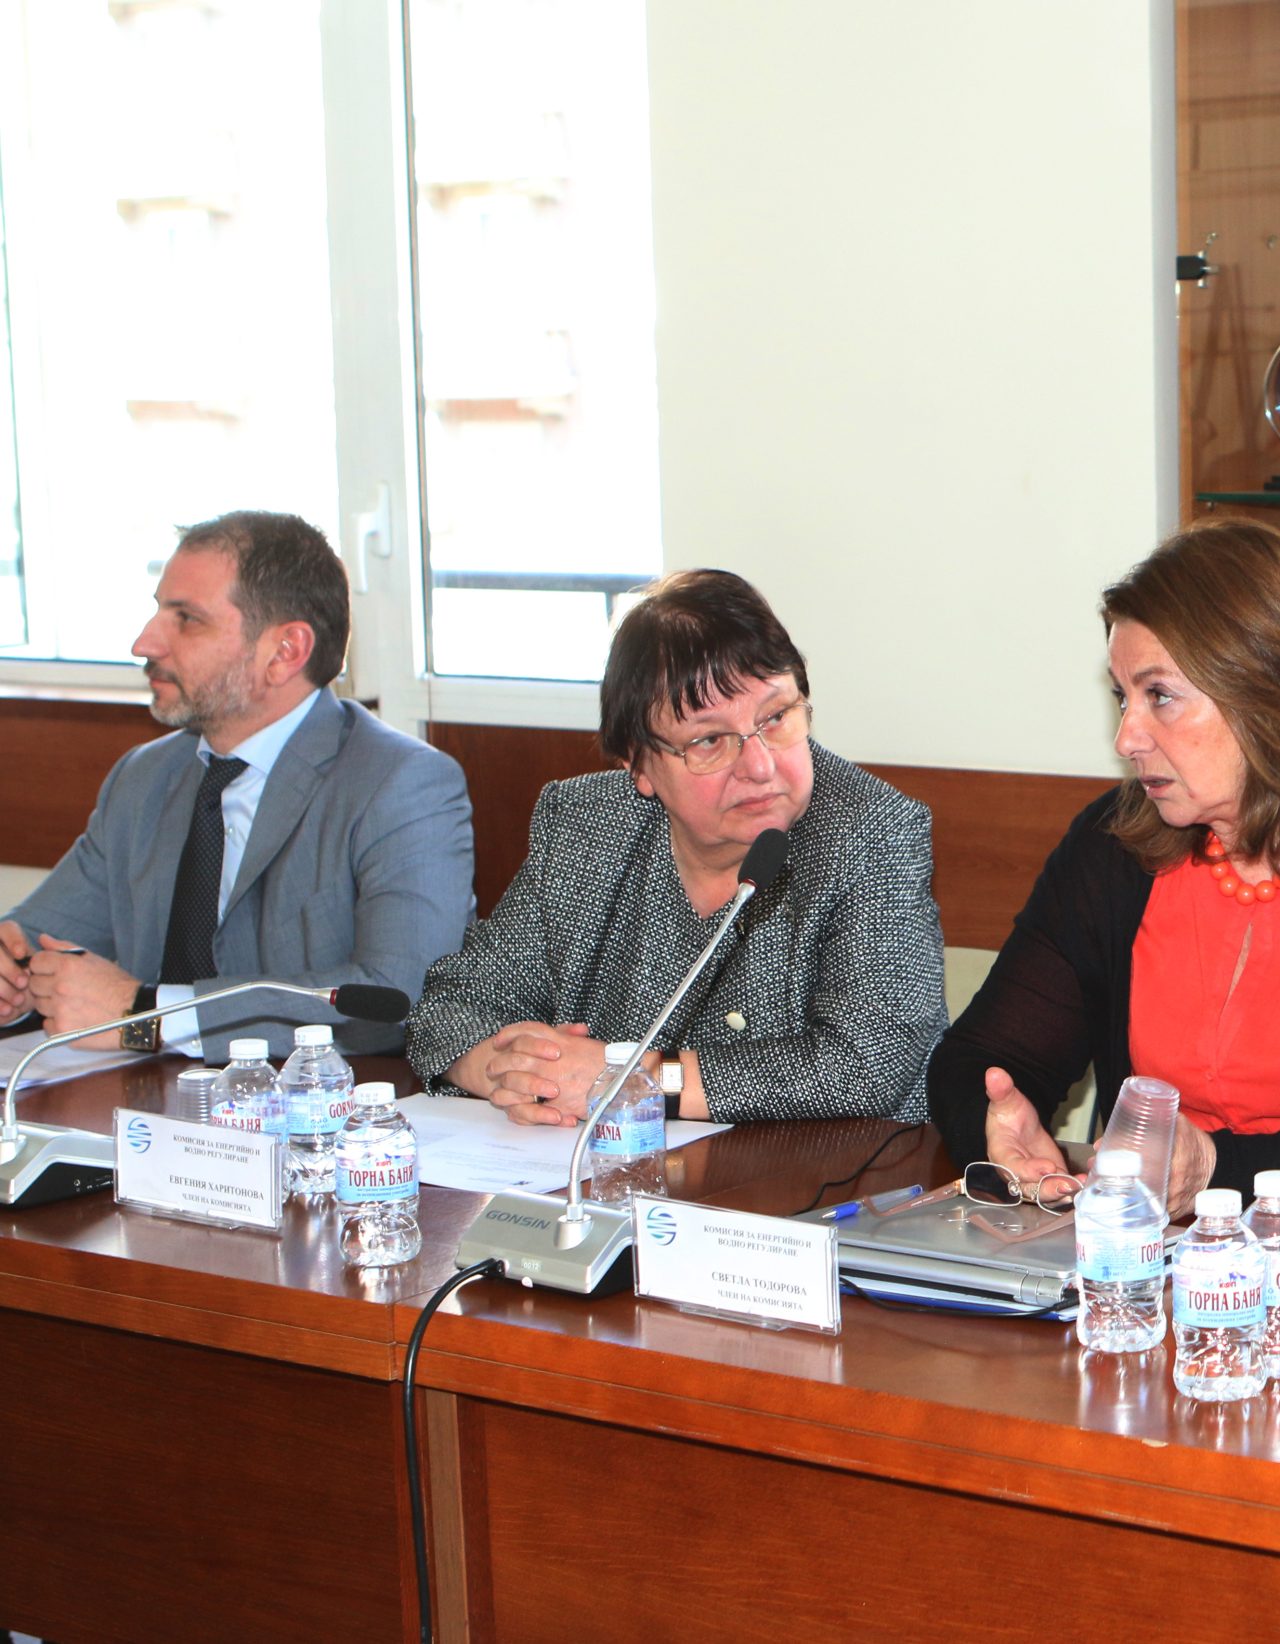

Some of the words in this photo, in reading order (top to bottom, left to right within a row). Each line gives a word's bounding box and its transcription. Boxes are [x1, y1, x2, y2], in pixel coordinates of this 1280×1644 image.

[329, 1100, 357, 1118] GORN
[595, 1124, 621, 1141] BANIA
[173, 1134, 206, 1147] КОМИСИЯ
[207, 1139, 214, 1148] ЗА
[215, 1141, 254, 1155] ЕНЕРГИЙНО
[184, 1146, 206, 1155] ВОДНО
[207, 1150, 248, 1164] РЕГУЛИРАНЕ
[349, 1170, 385, 1187] ГОРНА
[388, 1165, 414, 1186] БАНЯ
[169, 1174, 207, 1189] ЕВГЕНИЯ
[208, 1182, 265, 1201] ХАРИТОНОВА
[182, 1193, 200, 1202] ЧЛЕН
[201, 1196, 209, 1205] НА
[210, 1198, 252, 1213] КОМИСИЯТА
[486, 1210, 551, 1230] GONSIN
[703, 1225, 744, 1238] КОМИСИЯ
[747, 1231, 755, 1240] ЗА
[757, 1232, 804, 1248] ЕНЕРГИЙНО
[718, 1238, 745, 1248] ВОДНО
[747, 1242, 799, 1257] РЕГУЛИРАНЕ
[711, 1271, 751, 1287] СВЕТЛА
[753, 1278, 807, 1296] ТОДОРОВА
[718, 1289, 738, 1300] ЧЛЕН
[741, 1293, 751, 1302] НА
[753, 1295, 803, 1311] КОМИСИЯТА
[1189, 1291, 1229, 1311] ГОРНА
[1233, 1287, 1261, 1310] БАНЯ
